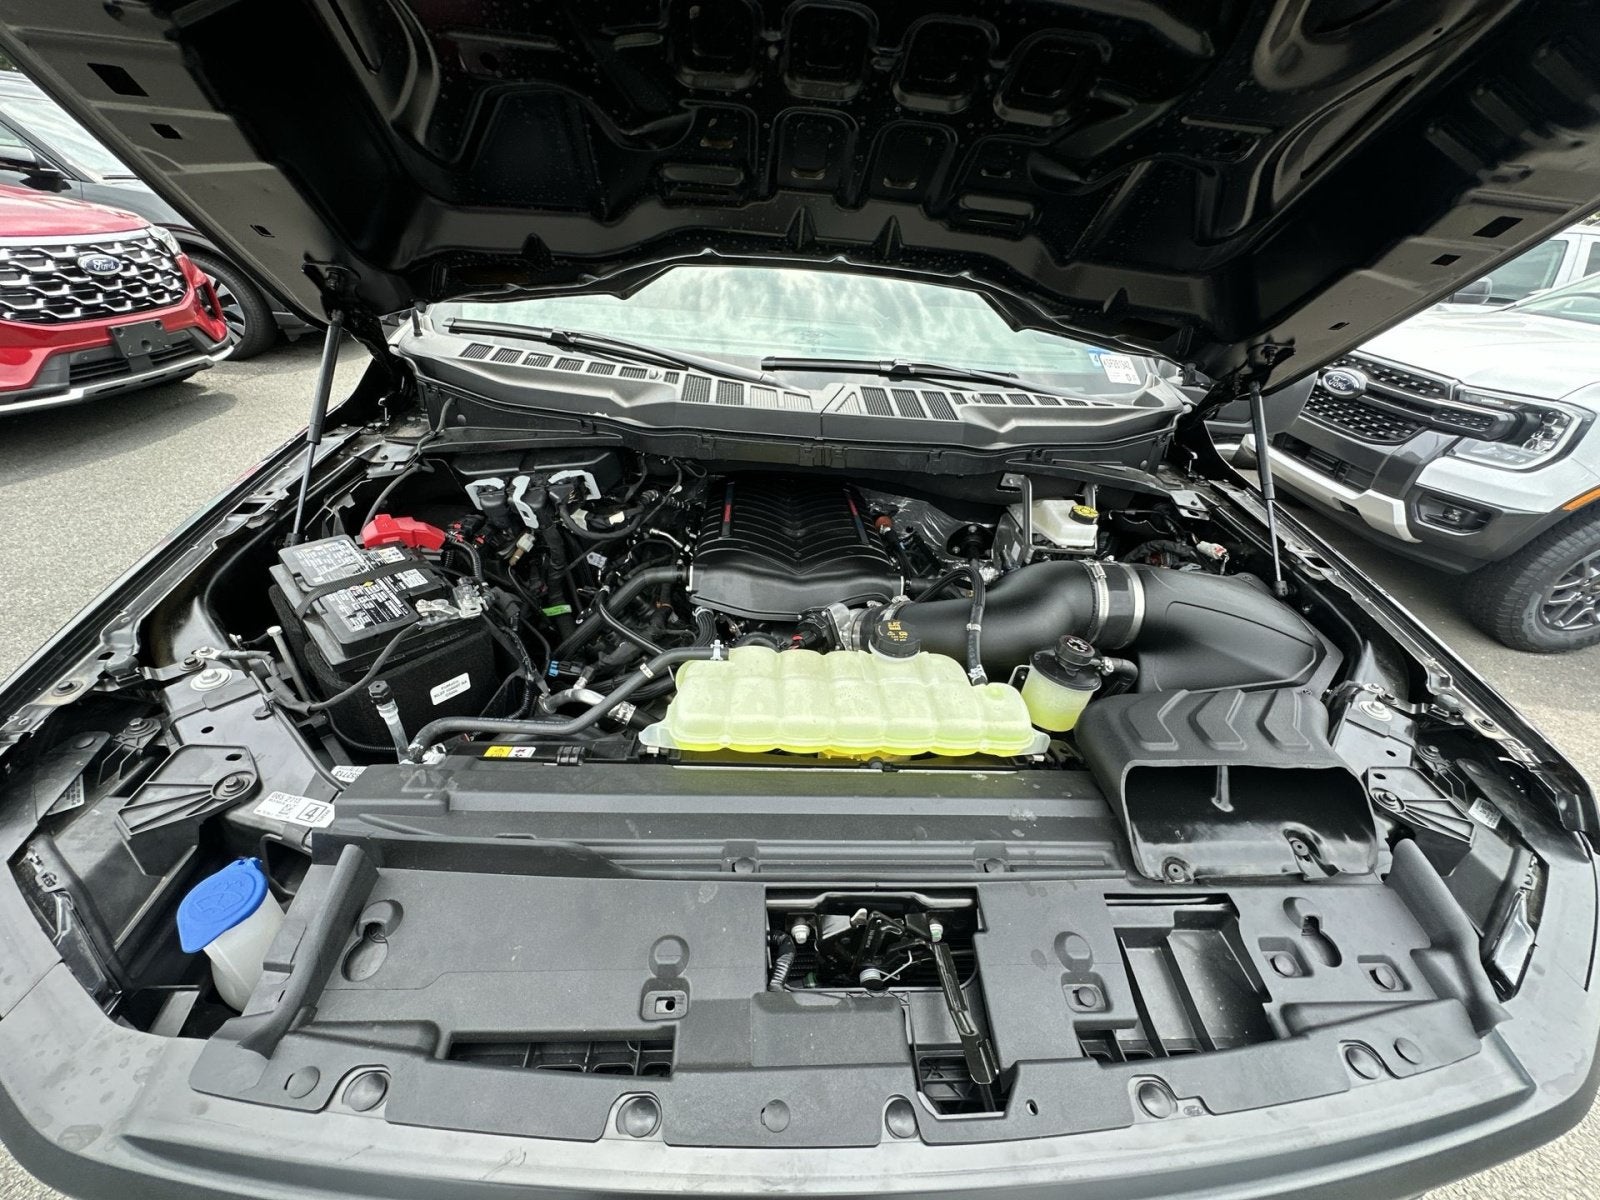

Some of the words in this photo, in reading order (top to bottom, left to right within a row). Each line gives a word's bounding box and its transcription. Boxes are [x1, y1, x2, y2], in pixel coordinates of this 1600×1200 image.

[92, 259, 116, 271] Ford
[1328, 375, 1351, 390] Ford
[305, 807, 319, 820] 4
